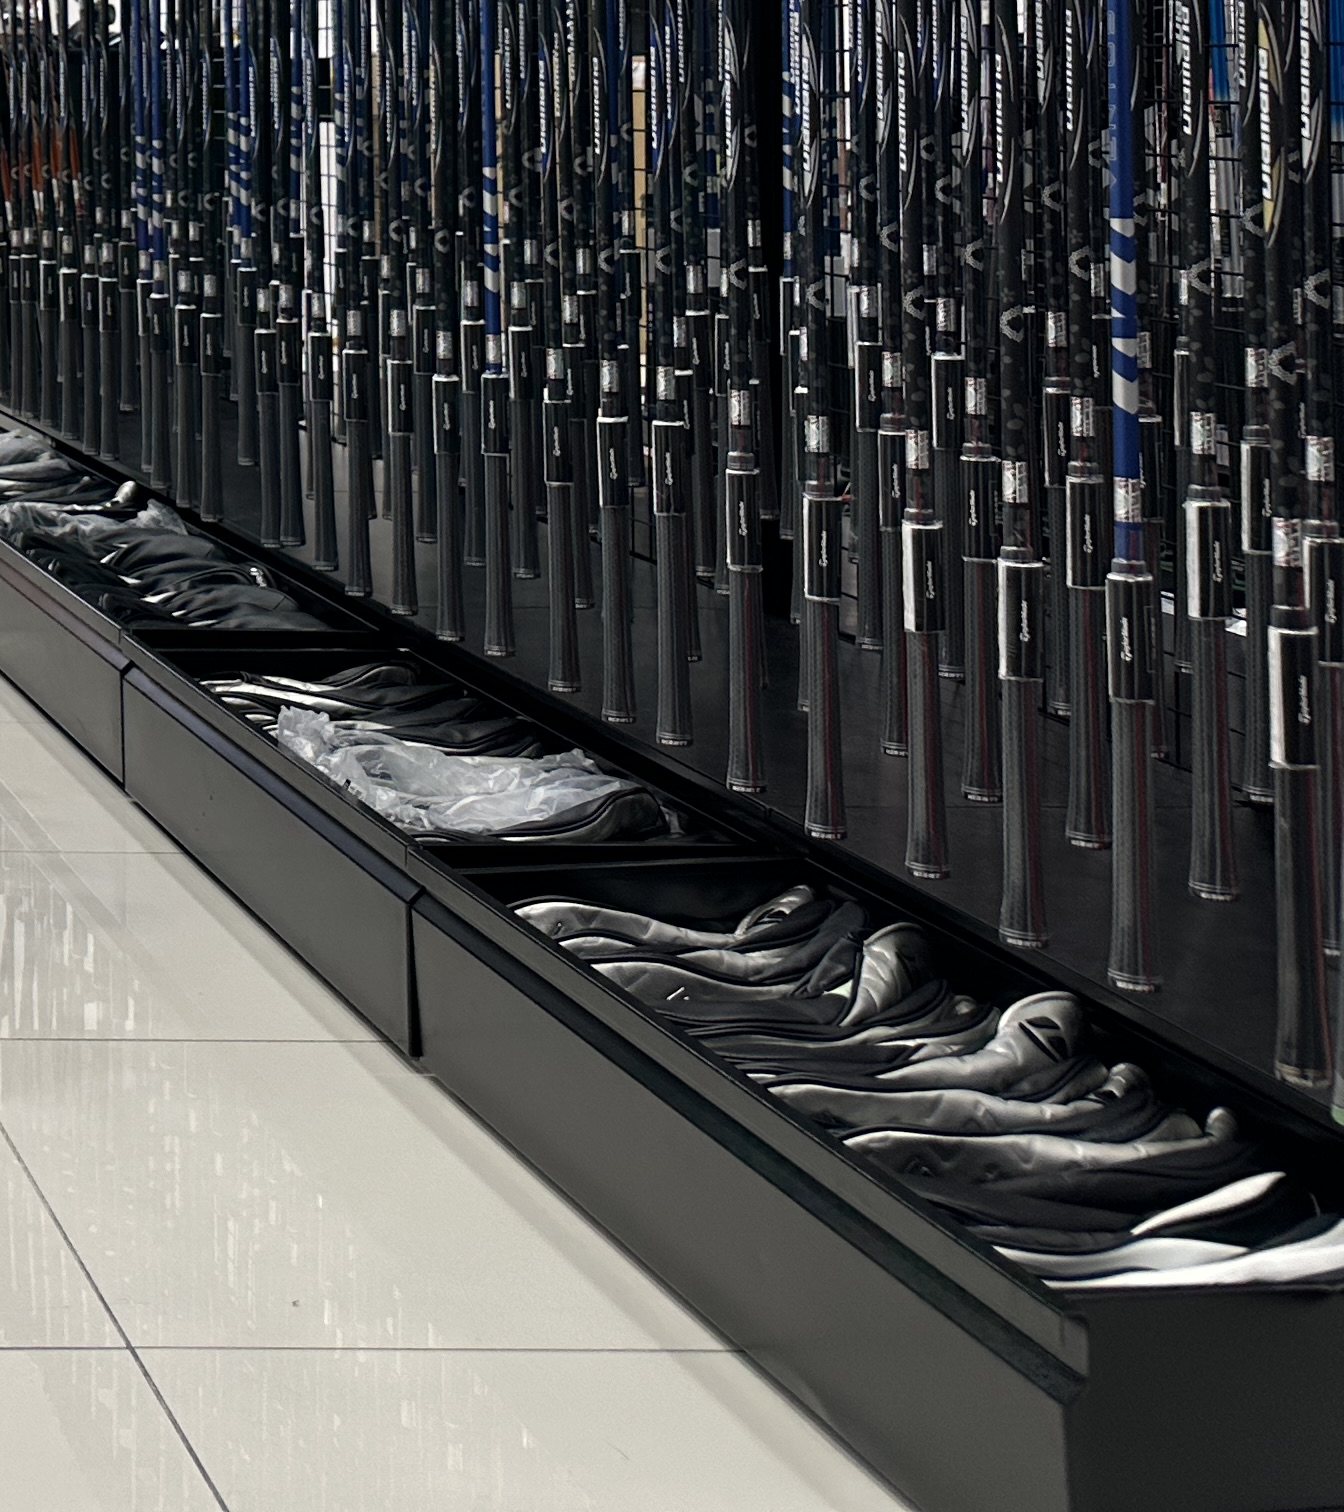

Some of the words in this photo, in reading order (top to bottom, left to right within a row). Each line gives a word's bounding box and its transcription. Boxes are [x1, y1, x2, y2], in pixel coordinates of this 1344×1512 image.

[897, 51, 907, 172] Diamana
[1181, 4, 1192, 135] Diamana
[1258, 47, 1272, 200] Diamana
